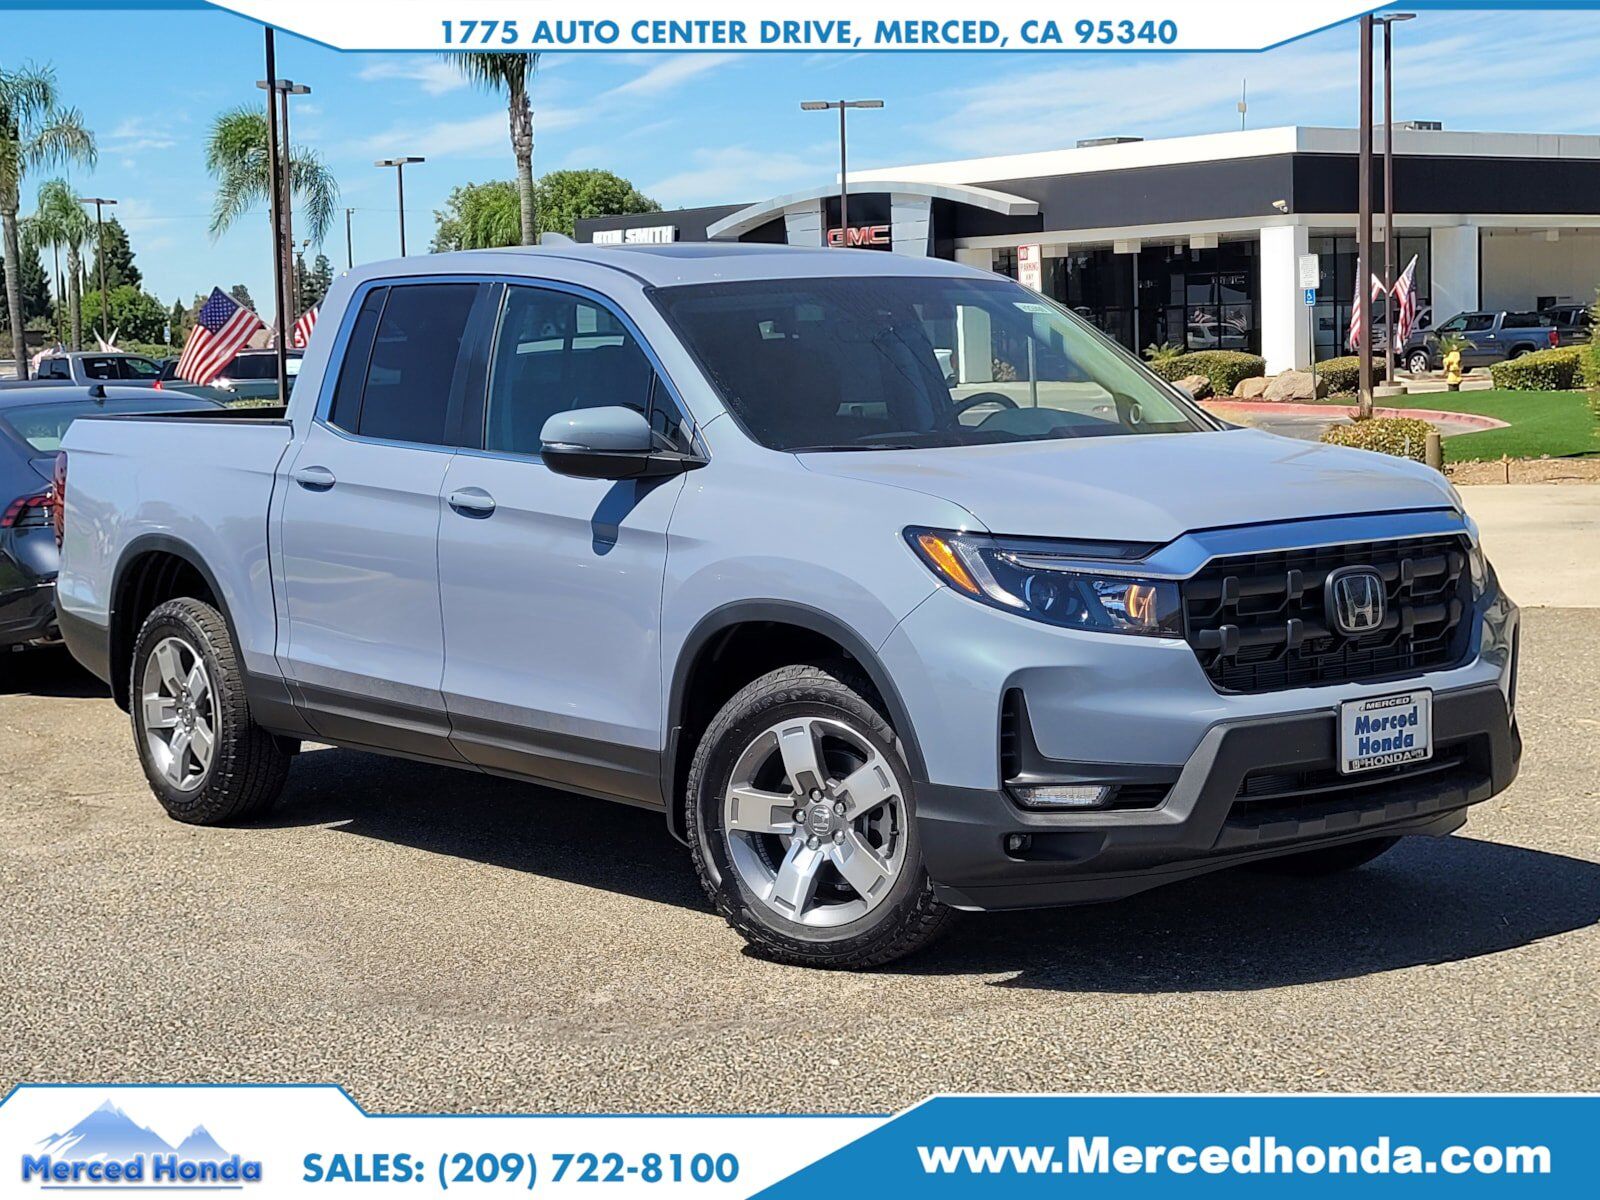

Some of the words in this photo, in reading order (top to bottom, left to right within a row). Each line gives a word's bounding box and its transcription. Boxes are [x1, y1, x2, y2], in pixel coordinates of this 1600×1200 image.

[624, 225, 676, 244] SMITH
[827, 225, 890, 247] GMC
[1366, 696, 1410, 710] MERCED
[1355, 706, 1418, 736] Merced
[1359, 730, 1414, 756] Honda
[1365, 751, 1412, 767] HONDA
